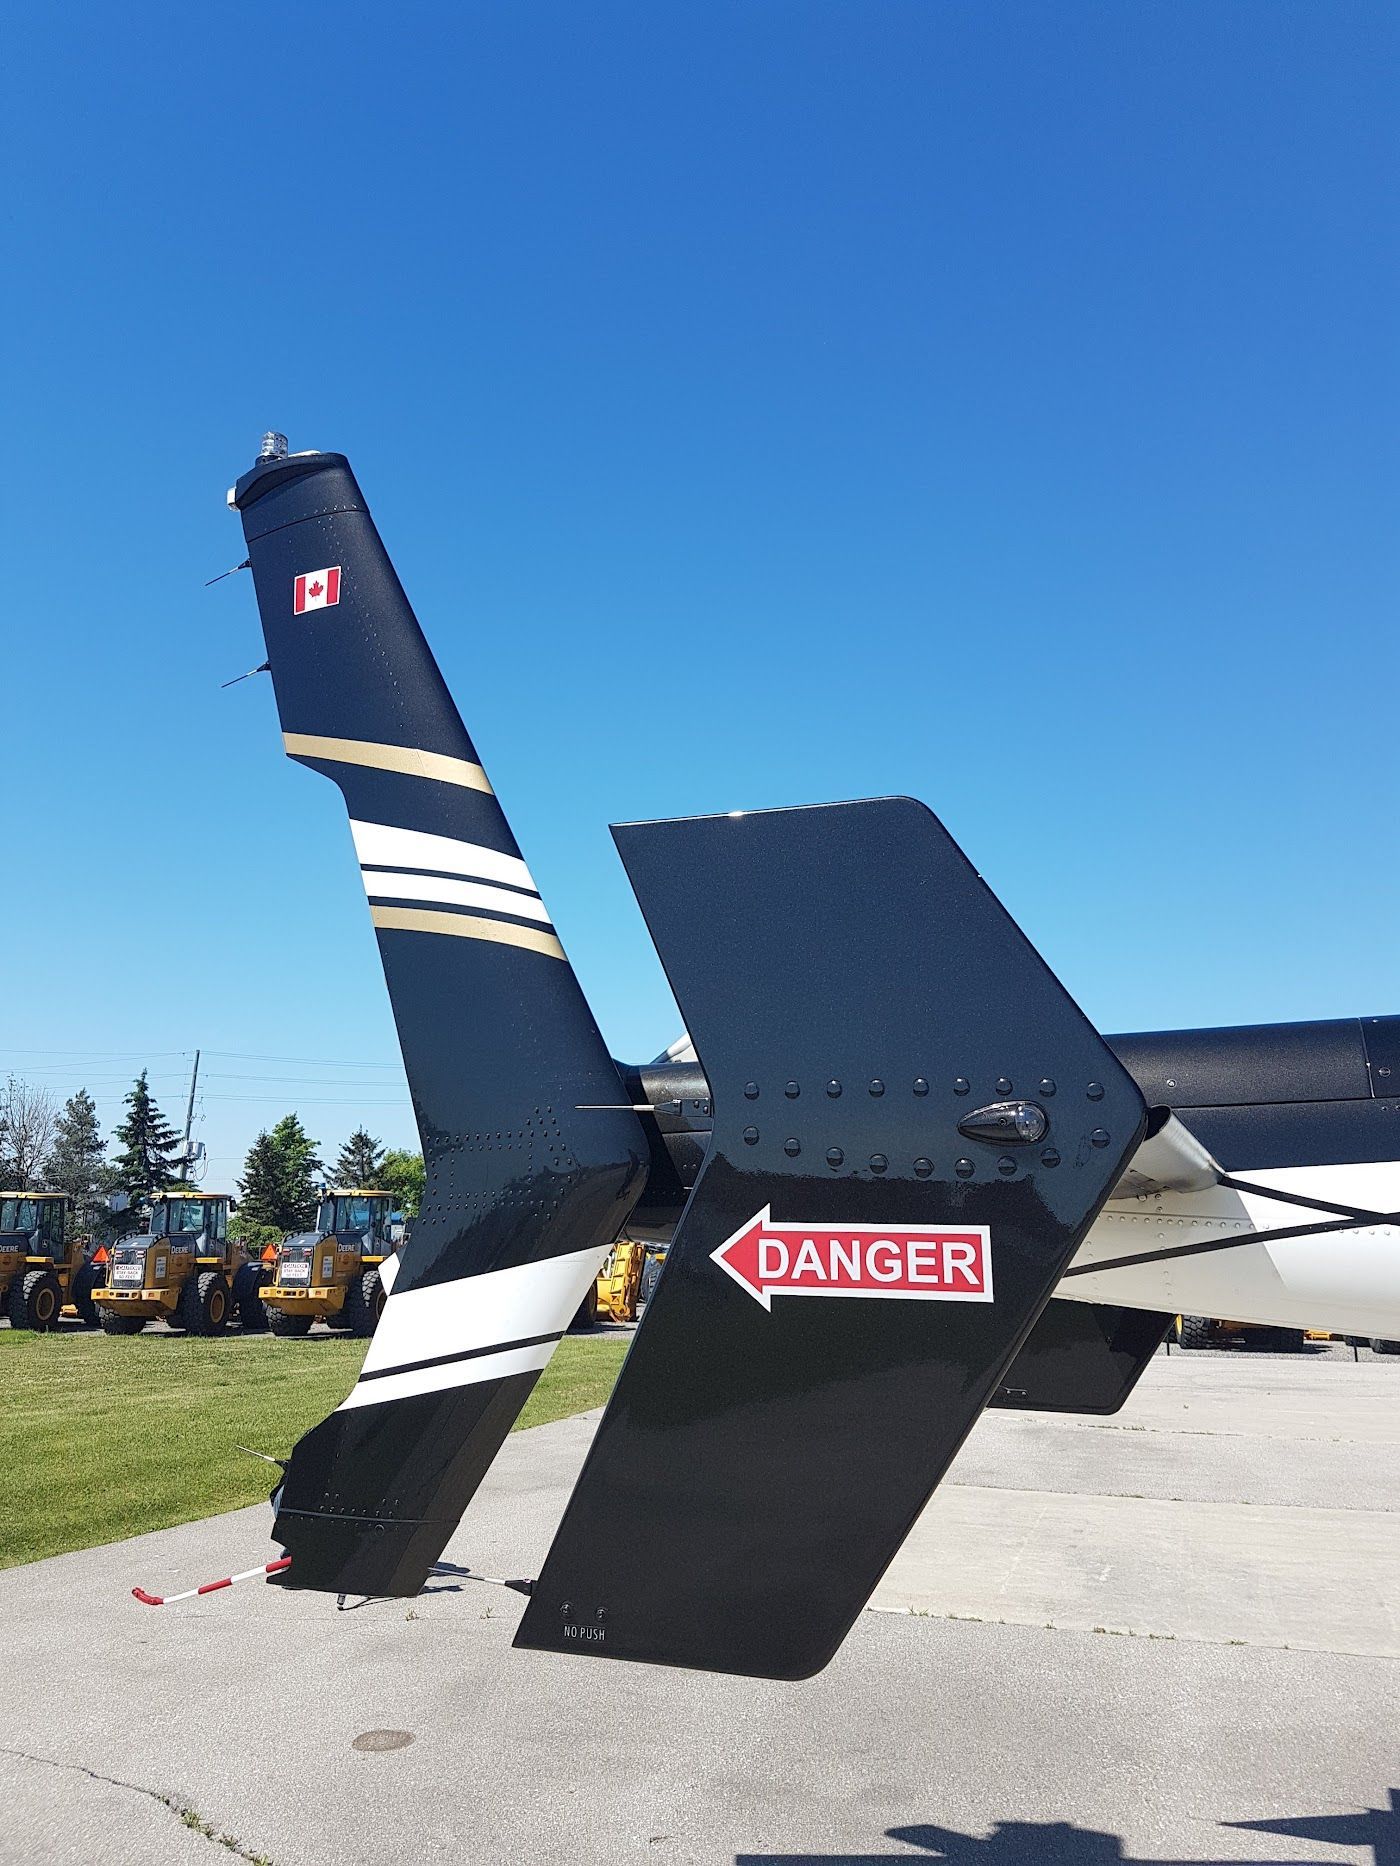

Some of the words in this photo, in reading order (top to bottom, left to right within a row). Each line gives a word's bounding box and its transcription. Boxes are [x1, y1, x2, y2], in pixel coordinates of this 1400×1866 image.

[757, 1238, 980, 1285] DANGER
[564, 1625, 577, 1638] NO
[580, 1627, 605, 1640] PUSH
